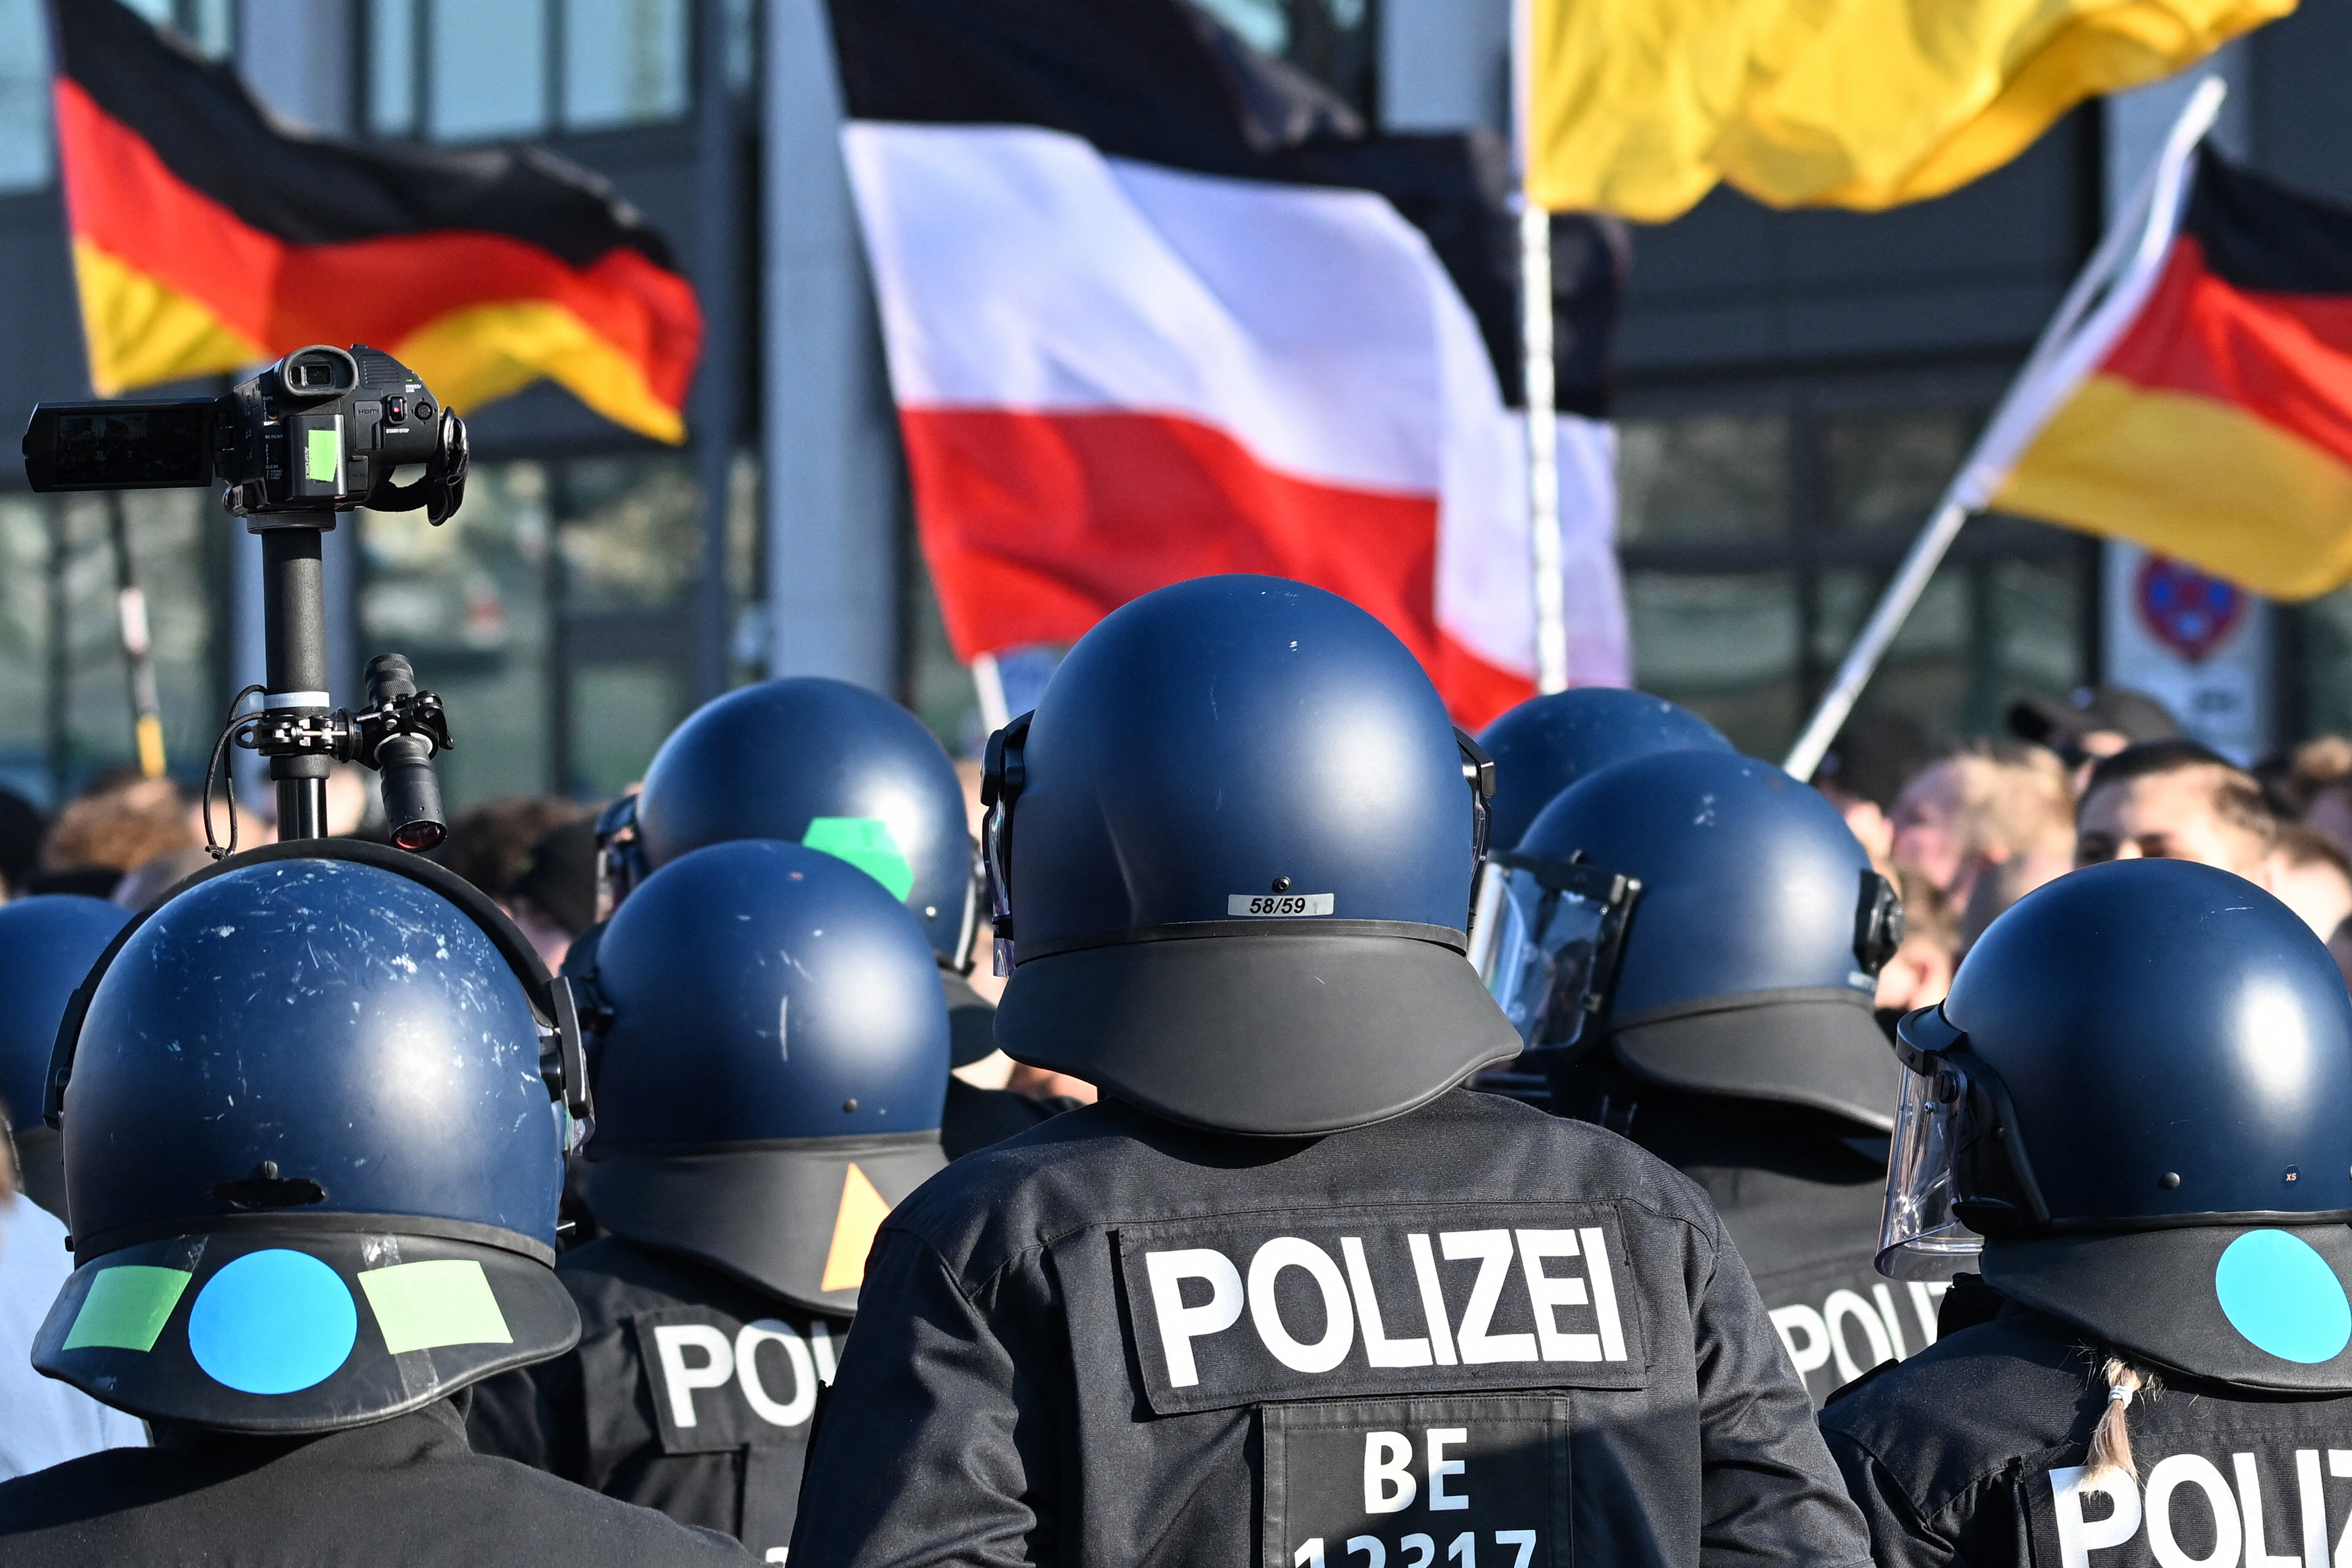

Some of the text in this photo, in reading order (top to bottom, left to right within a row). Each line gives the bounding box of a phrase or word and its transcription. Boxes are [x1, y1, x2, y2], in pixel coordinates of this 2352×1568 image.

[1250, 898, 1306, 914] 58/59
[2286, 1172, 2297, 1182] XS
[1145, 1227, 1628, 1388] POLIZEI
[1364, 1428, 1470, 1514] BE
